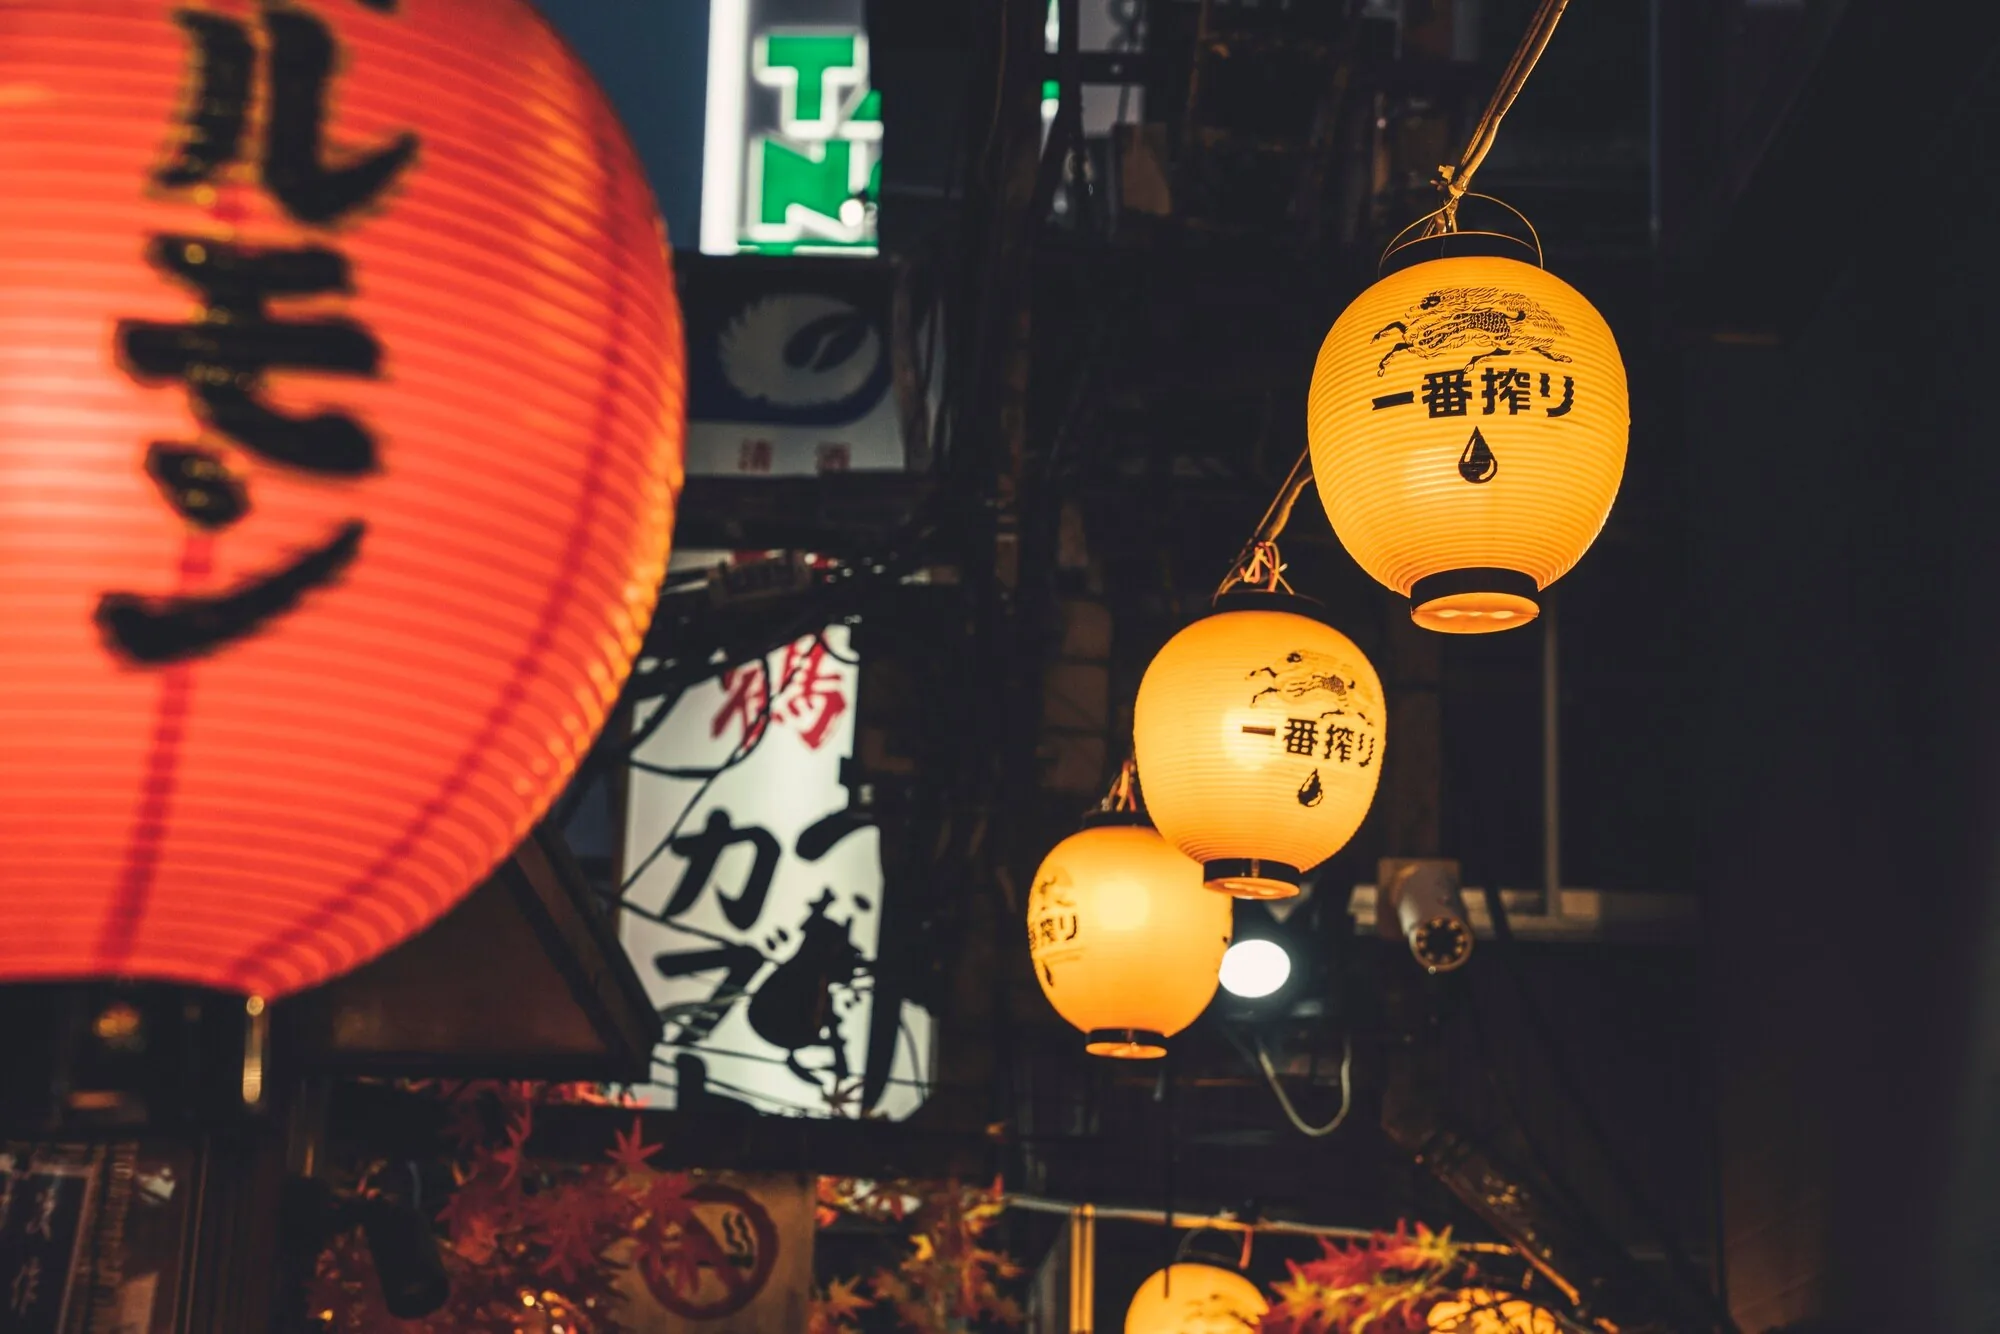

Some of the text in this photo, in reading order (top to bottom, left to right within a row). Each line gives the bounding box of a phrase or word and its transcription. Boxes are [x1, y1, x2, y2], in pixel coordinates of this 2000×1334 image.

[94, 0, 422, 668] ルモン
[1371, 367, 1575, 419] 一番搾り
[1241, 717, 1375, 768] 一番搾り
